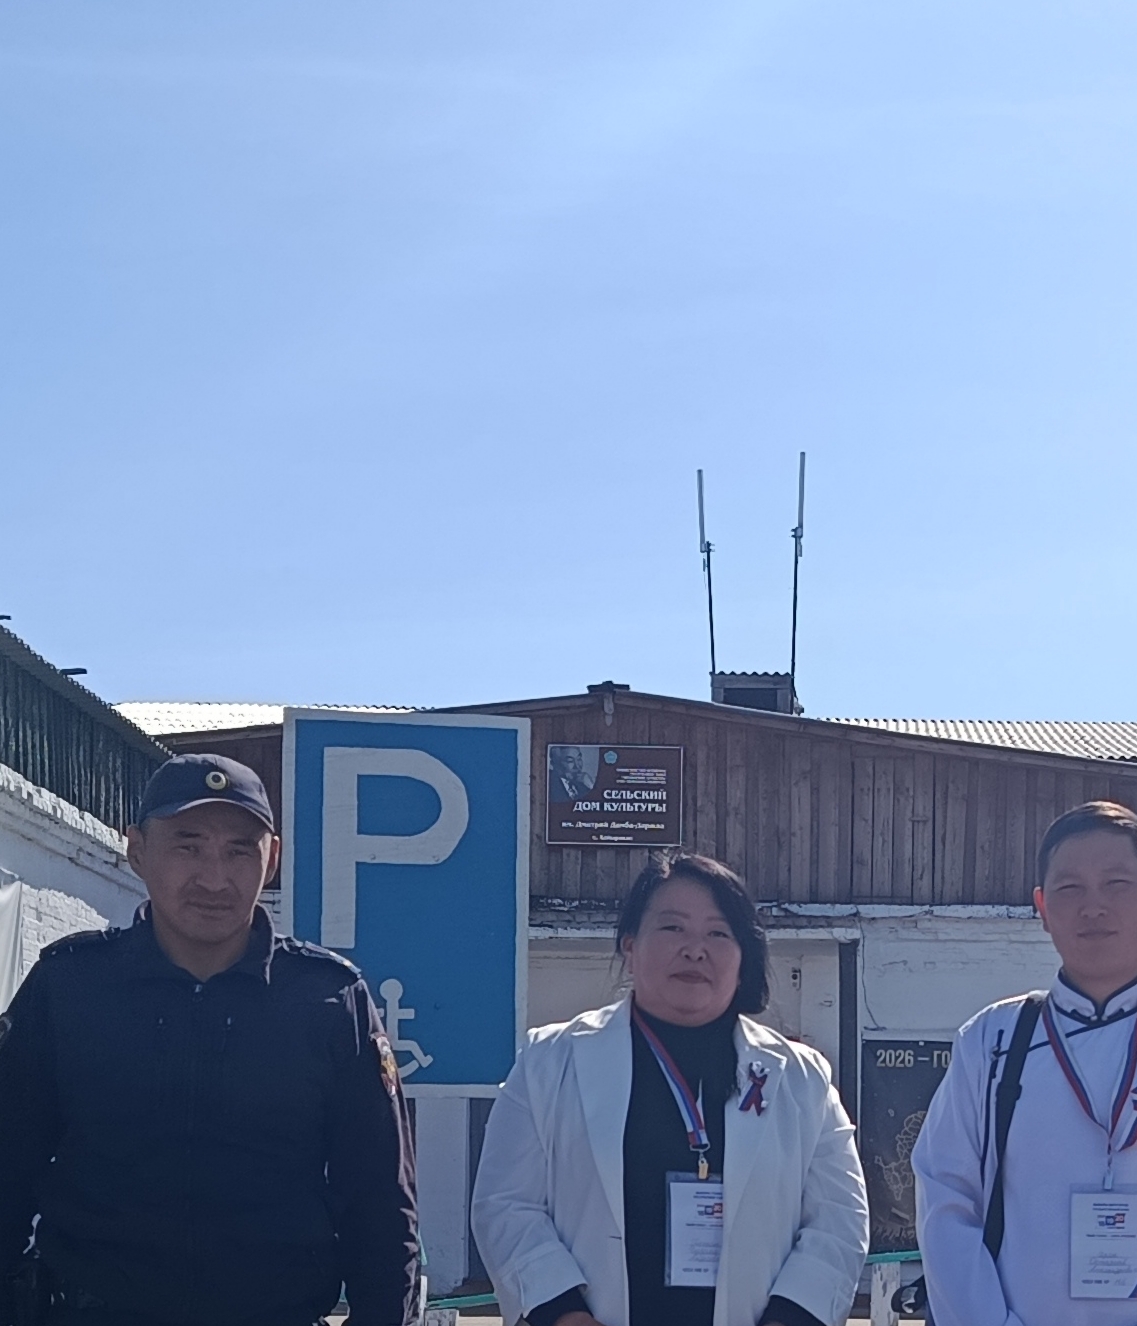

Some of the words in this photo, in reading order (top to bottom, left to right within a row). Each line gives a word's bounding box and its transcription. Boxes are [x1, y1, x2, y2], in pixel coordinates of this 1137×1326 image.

[603, 788, 667, 801] СЕЛЬСКИЙ
[572, 801, 600, 812] ДОМ
[603, 801, 667, 813] КУЛЬТУРЫ
[321, 746, 469, 949] P
[876, 1049, 914, 1068] 2026
